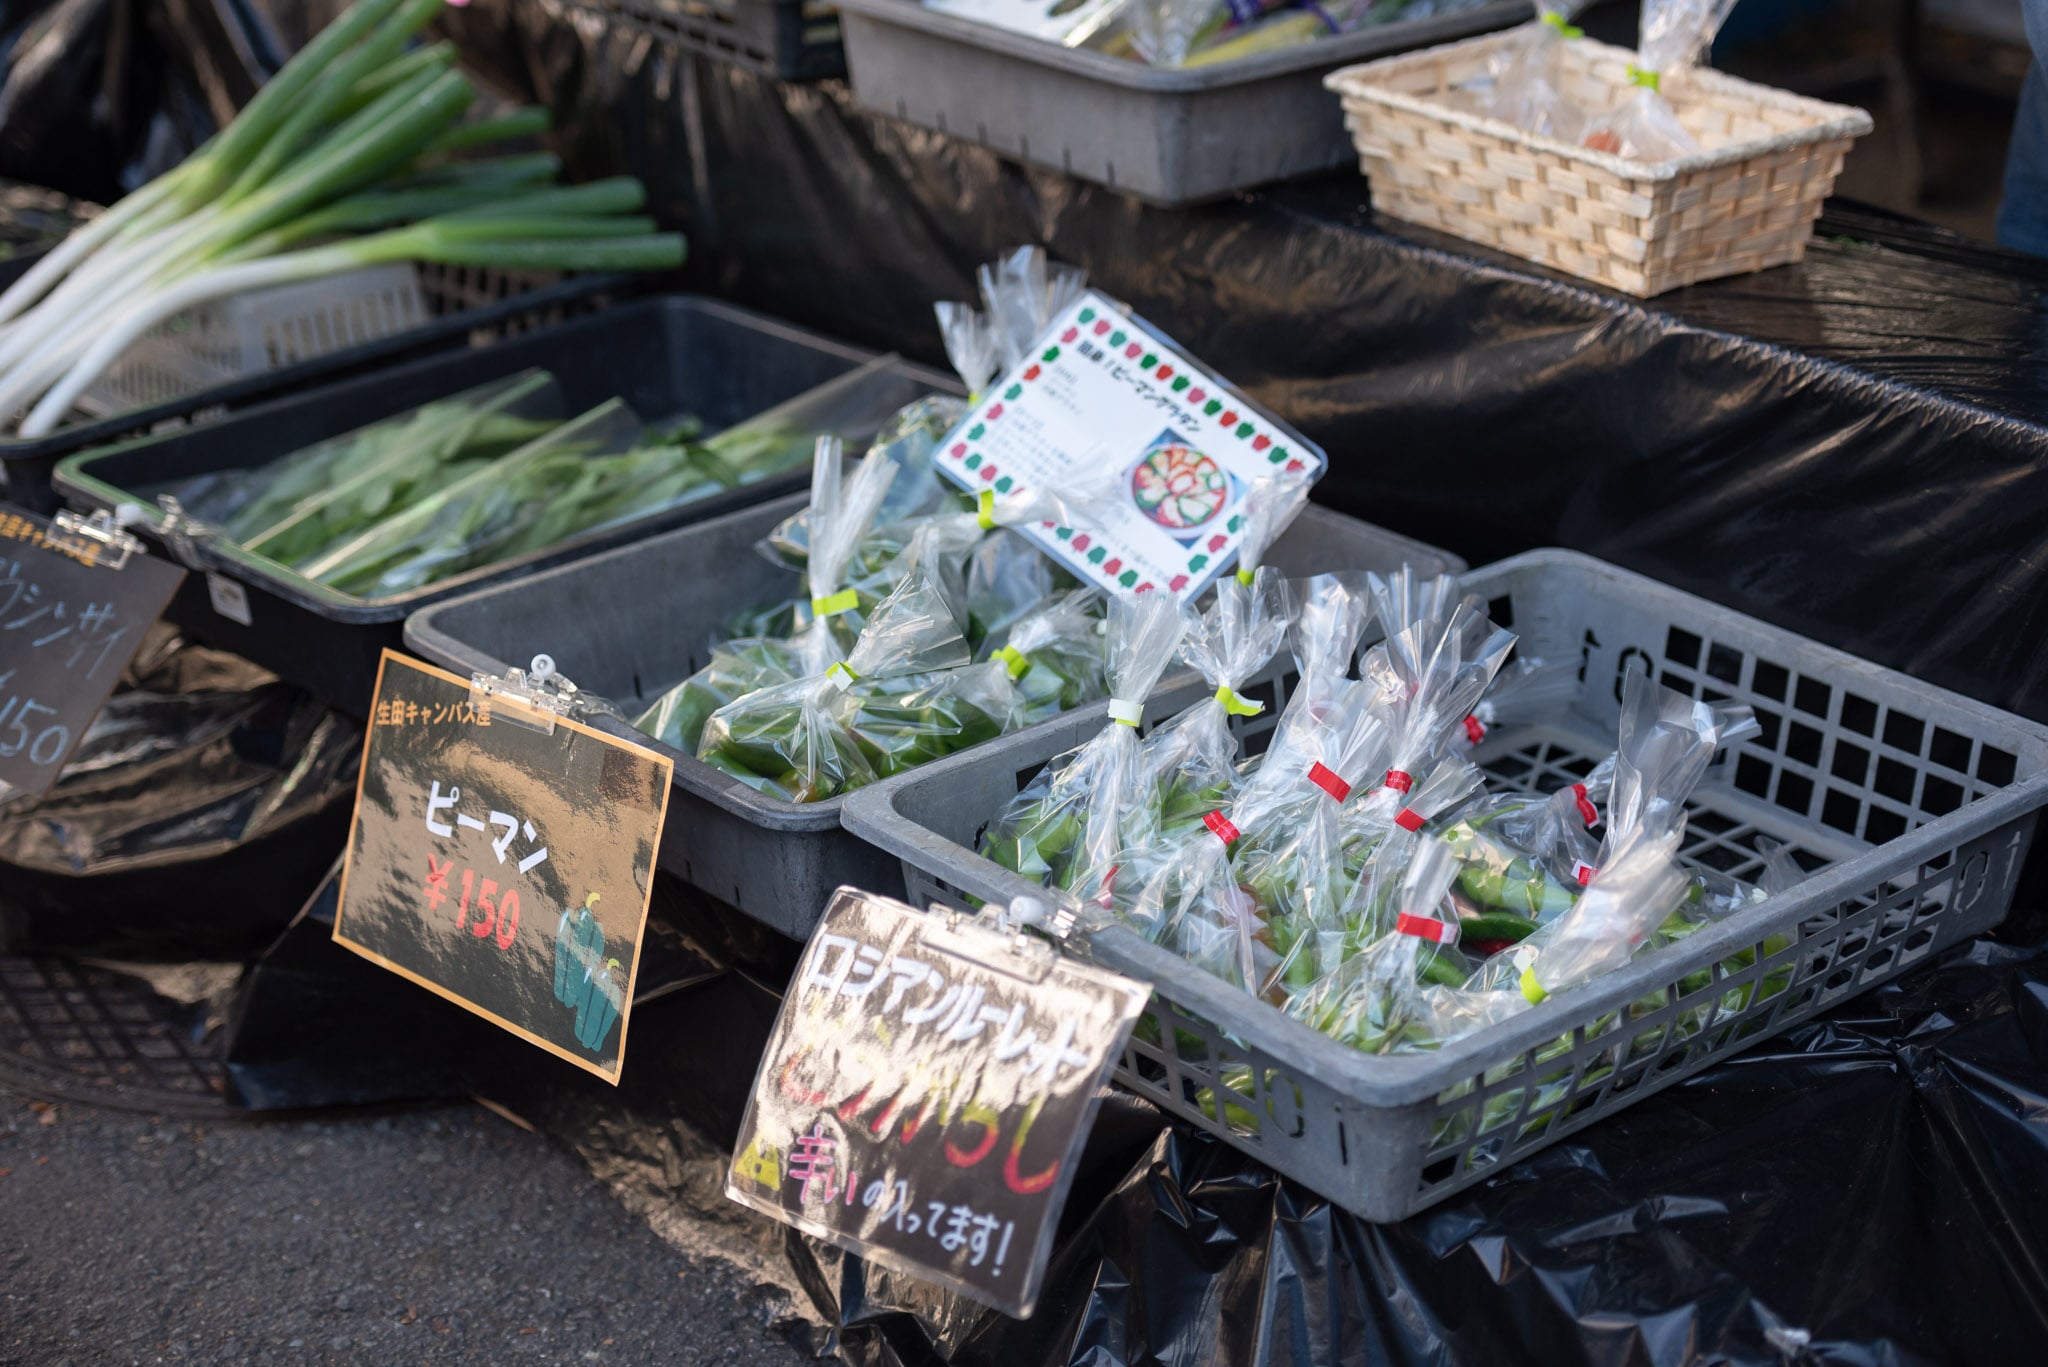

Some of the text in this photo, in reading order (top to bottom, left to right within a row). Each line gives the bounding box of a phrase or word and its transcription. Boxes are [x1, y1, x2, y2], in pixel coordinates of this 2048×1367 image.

[424, 779, 548, 875] ピーマン
[422, 852, 520, 951] ¥150
